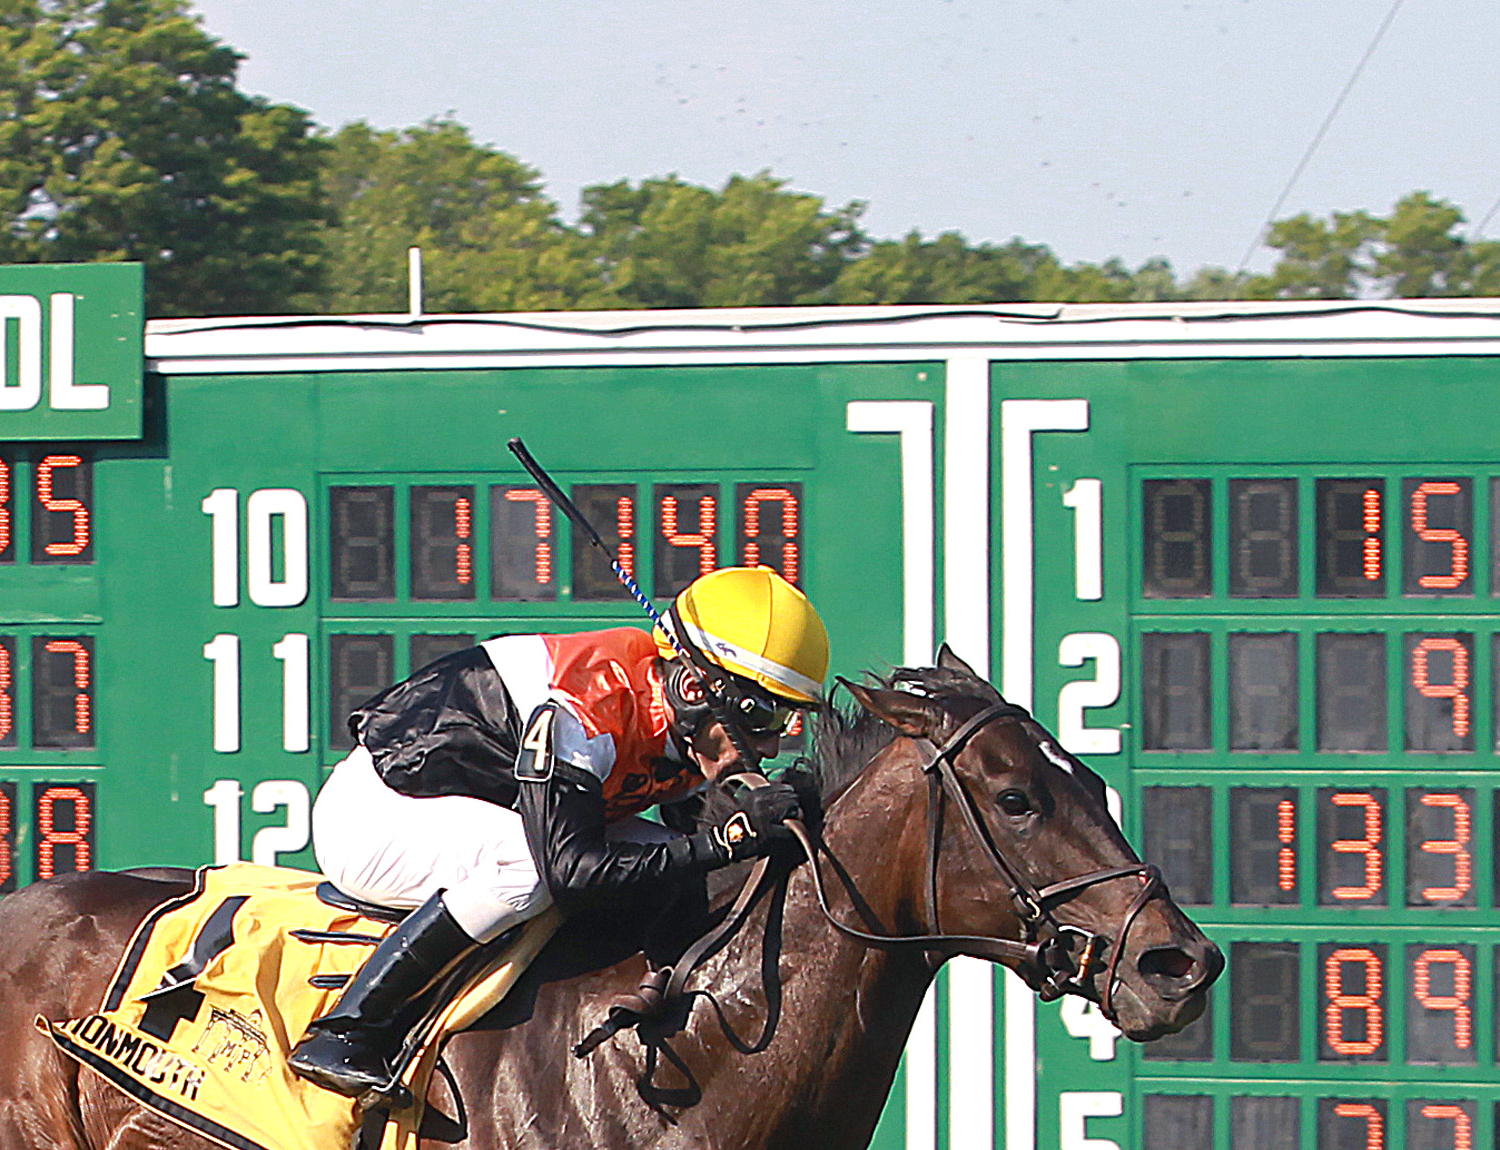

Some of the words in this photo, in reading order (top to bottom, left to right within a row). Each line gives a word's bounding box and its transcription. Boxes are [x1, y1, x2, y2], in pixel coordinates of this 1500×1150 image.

[202, 488, 308, 607] 10
[1063, 479, 1103, 600] 1
[1363, 482, 1468, 588] 15
[203, 633, 309, 753] 11
[523, 709, 554, 772] 4
[1059, 632, 1121, 754] 2
[1412, 639, 1468, 738] 9
[203, 779, 309, 867] 12
[1277, 793, 1471, 900] 133
[1326, 949, 1470, 1055] 89
